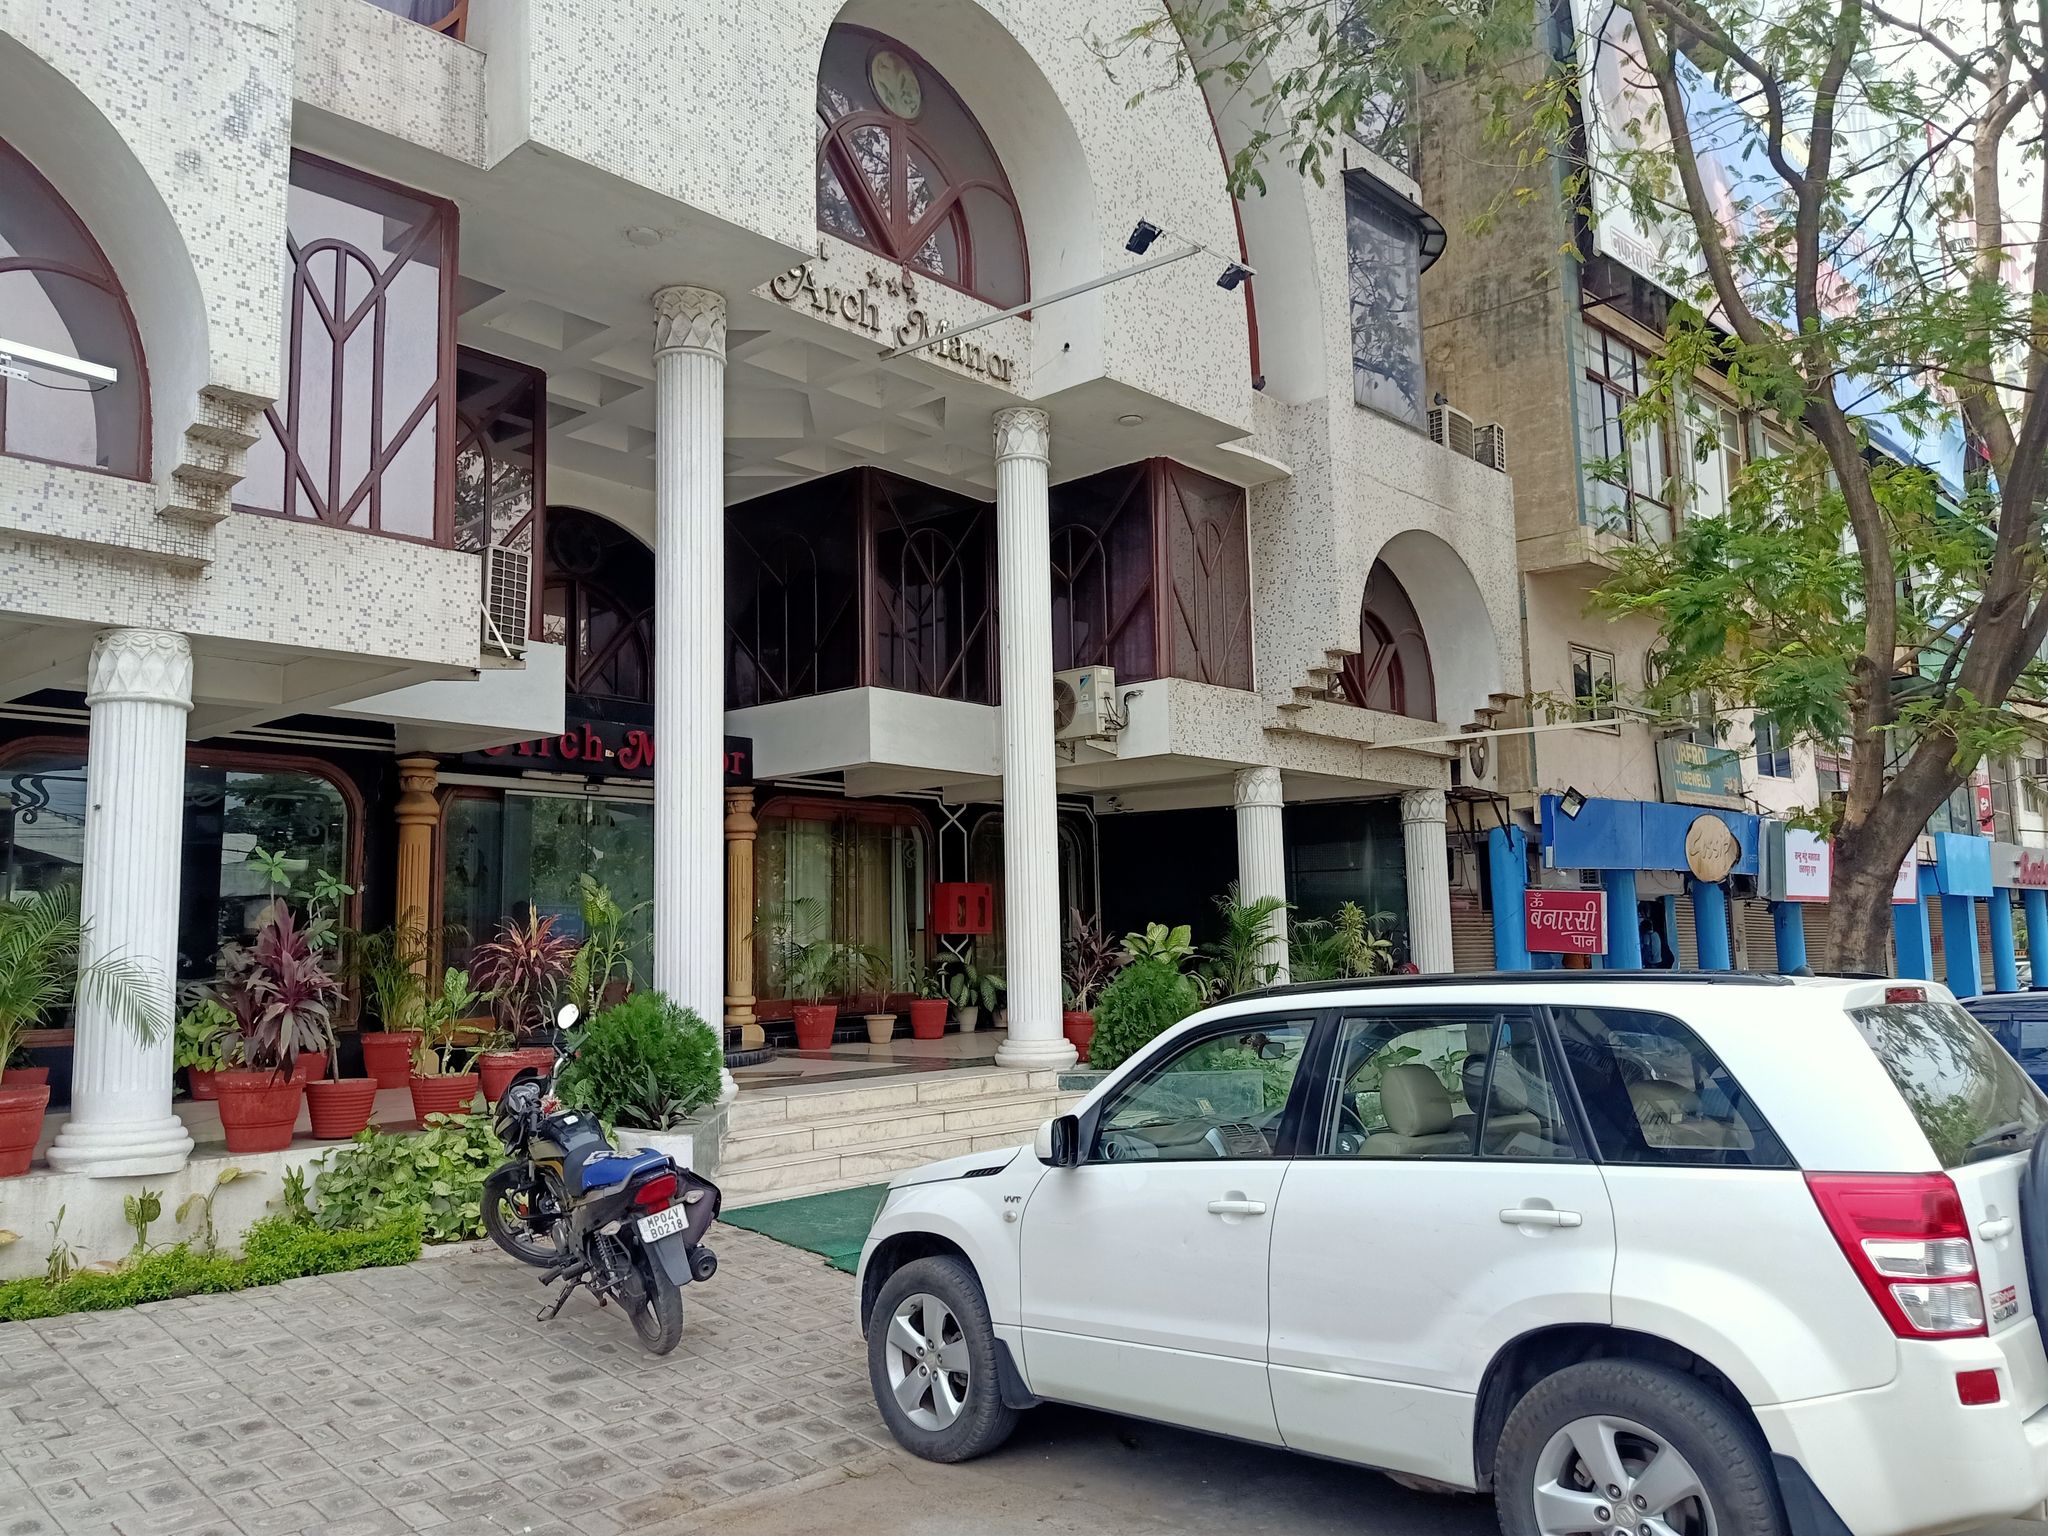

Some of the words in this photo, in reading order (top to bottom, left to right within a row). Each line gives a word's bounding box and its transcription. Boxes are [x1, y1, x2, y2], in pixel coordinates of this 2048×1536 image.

[770, 264, 881, 332] Arch
[896, 310, 1014, 383] Manor
[484, 722, 602, 763] rch
[1675, 770, 1712, 789] TUBEWELLS
[1530, 901, 1597, 931] बनारसी
[1571, 935, 1597, 952] पान
[646, 1207, 679, 1229] MP04V
[650, 1218, 683, 1239] B0218
